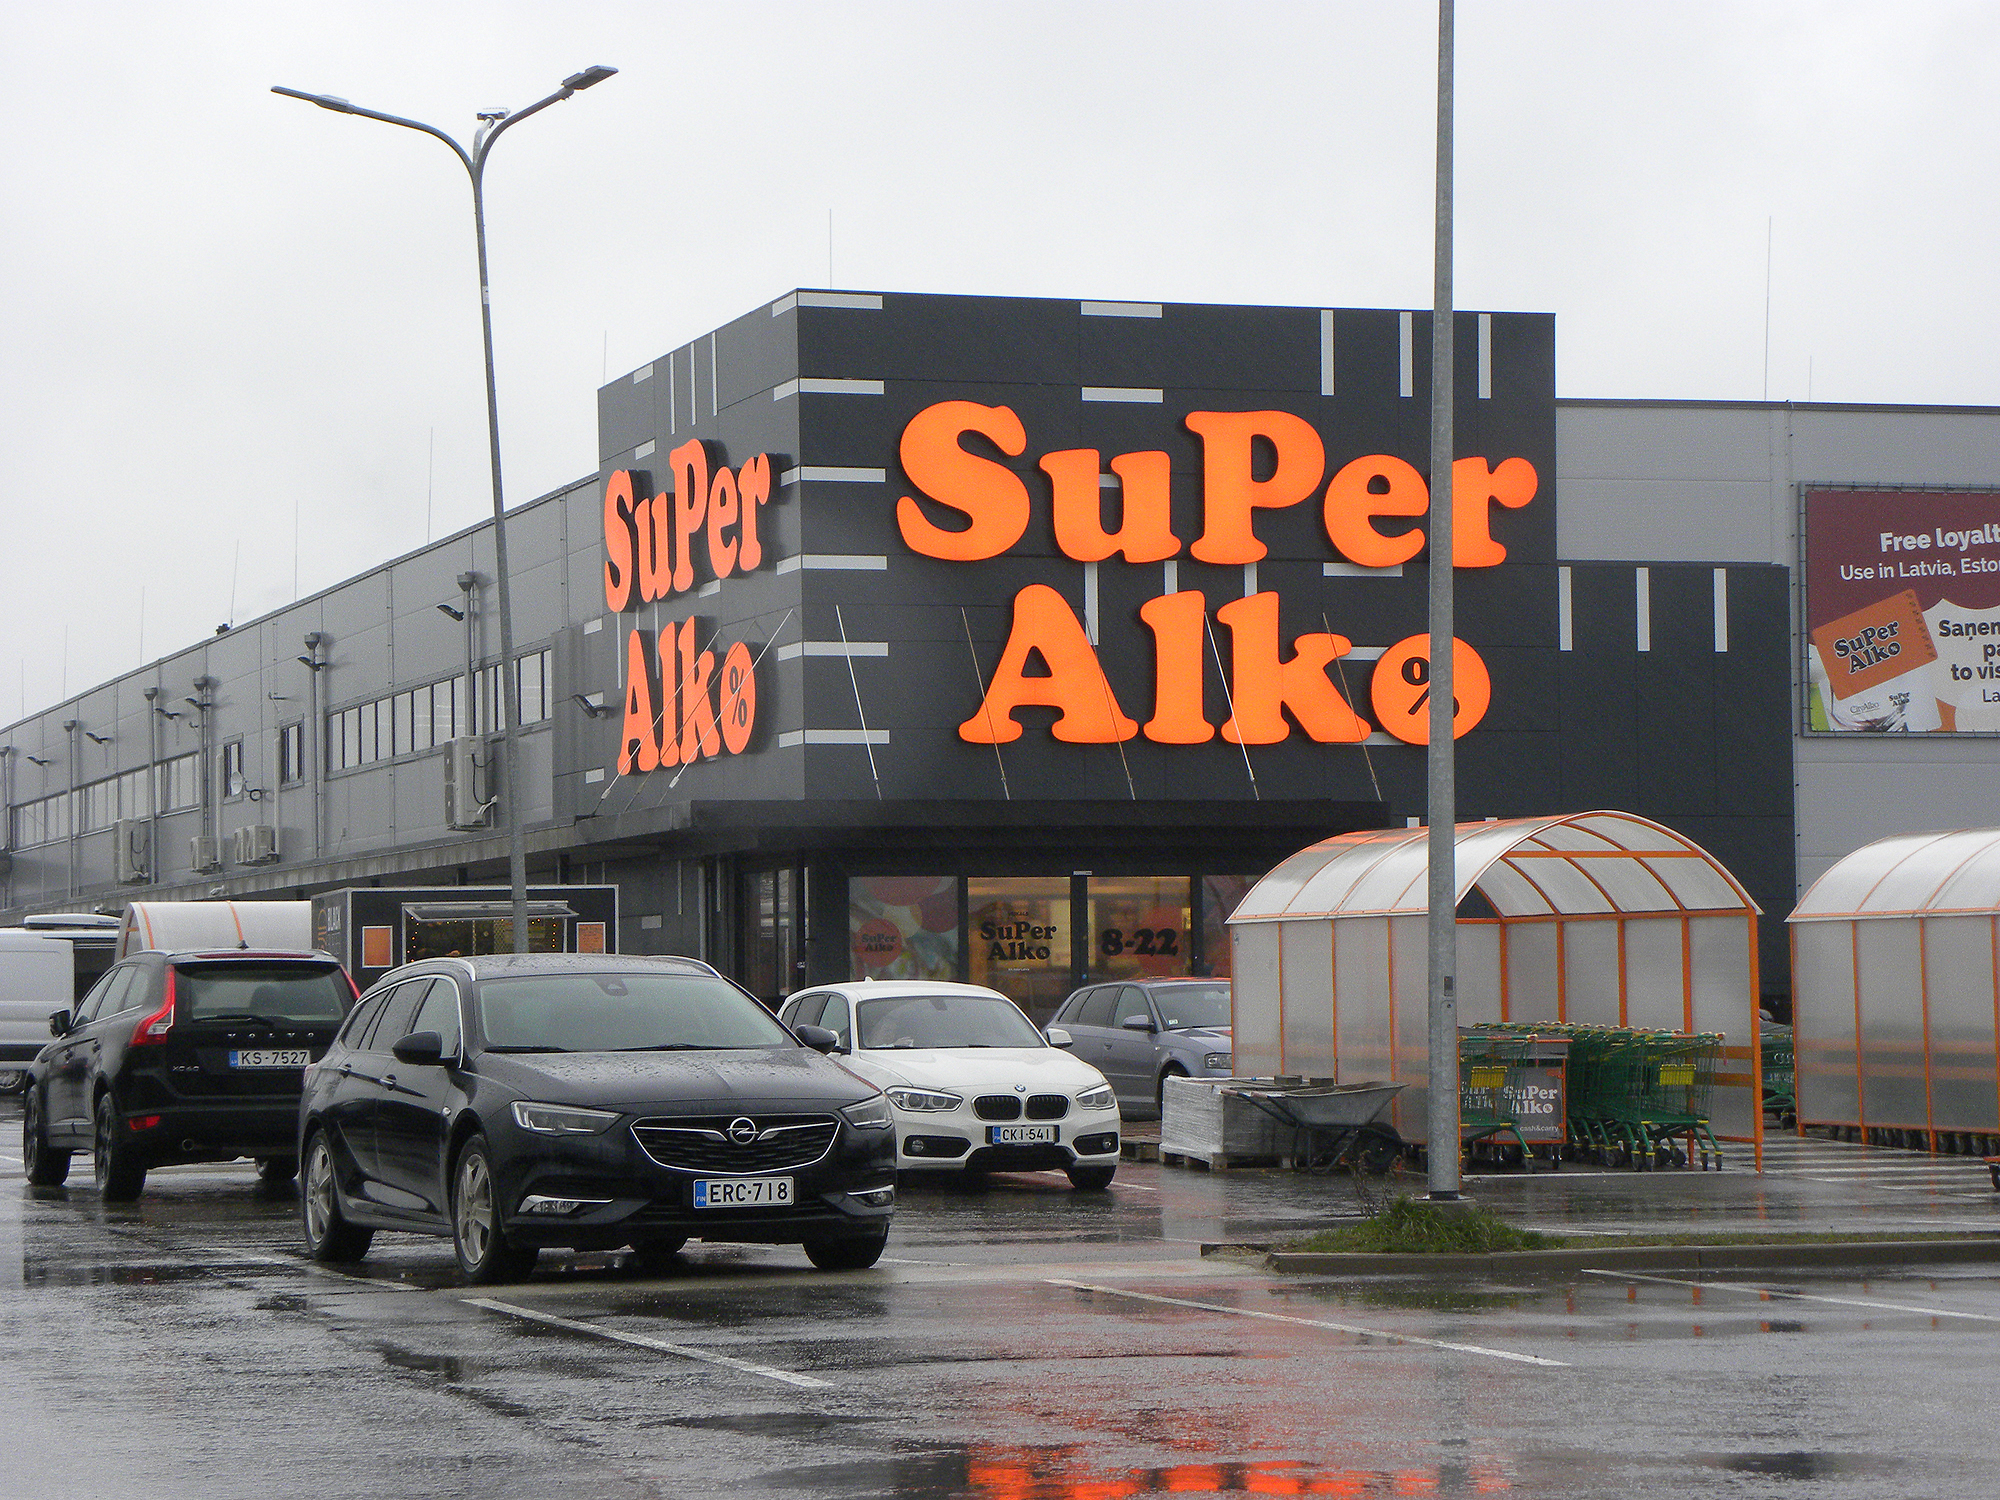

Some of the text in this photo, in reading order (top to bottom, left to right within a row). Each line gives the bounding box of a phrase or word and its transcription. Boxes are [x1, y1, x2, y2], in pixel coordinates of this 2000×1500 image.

[897, 400, 1538, 568] SuPer
[604, 438, 771, 613] SuPer
[1880, 523, 2000, 553] Free loyalt
[1840, 557, 2000, 581] Use in Latvia, Esto
[1834, 620, 1899, 659] SuPer
[1849, 641, 1902, 674] Alko
[1950, 663, 1973, 681] to
[980, 921, 1057, 940] SuPer
[1101, 928, 1179, 956] 8-22
[987, 941, 1051, 960] Alko
[241, 1051, 308, 1065] KS-7527
